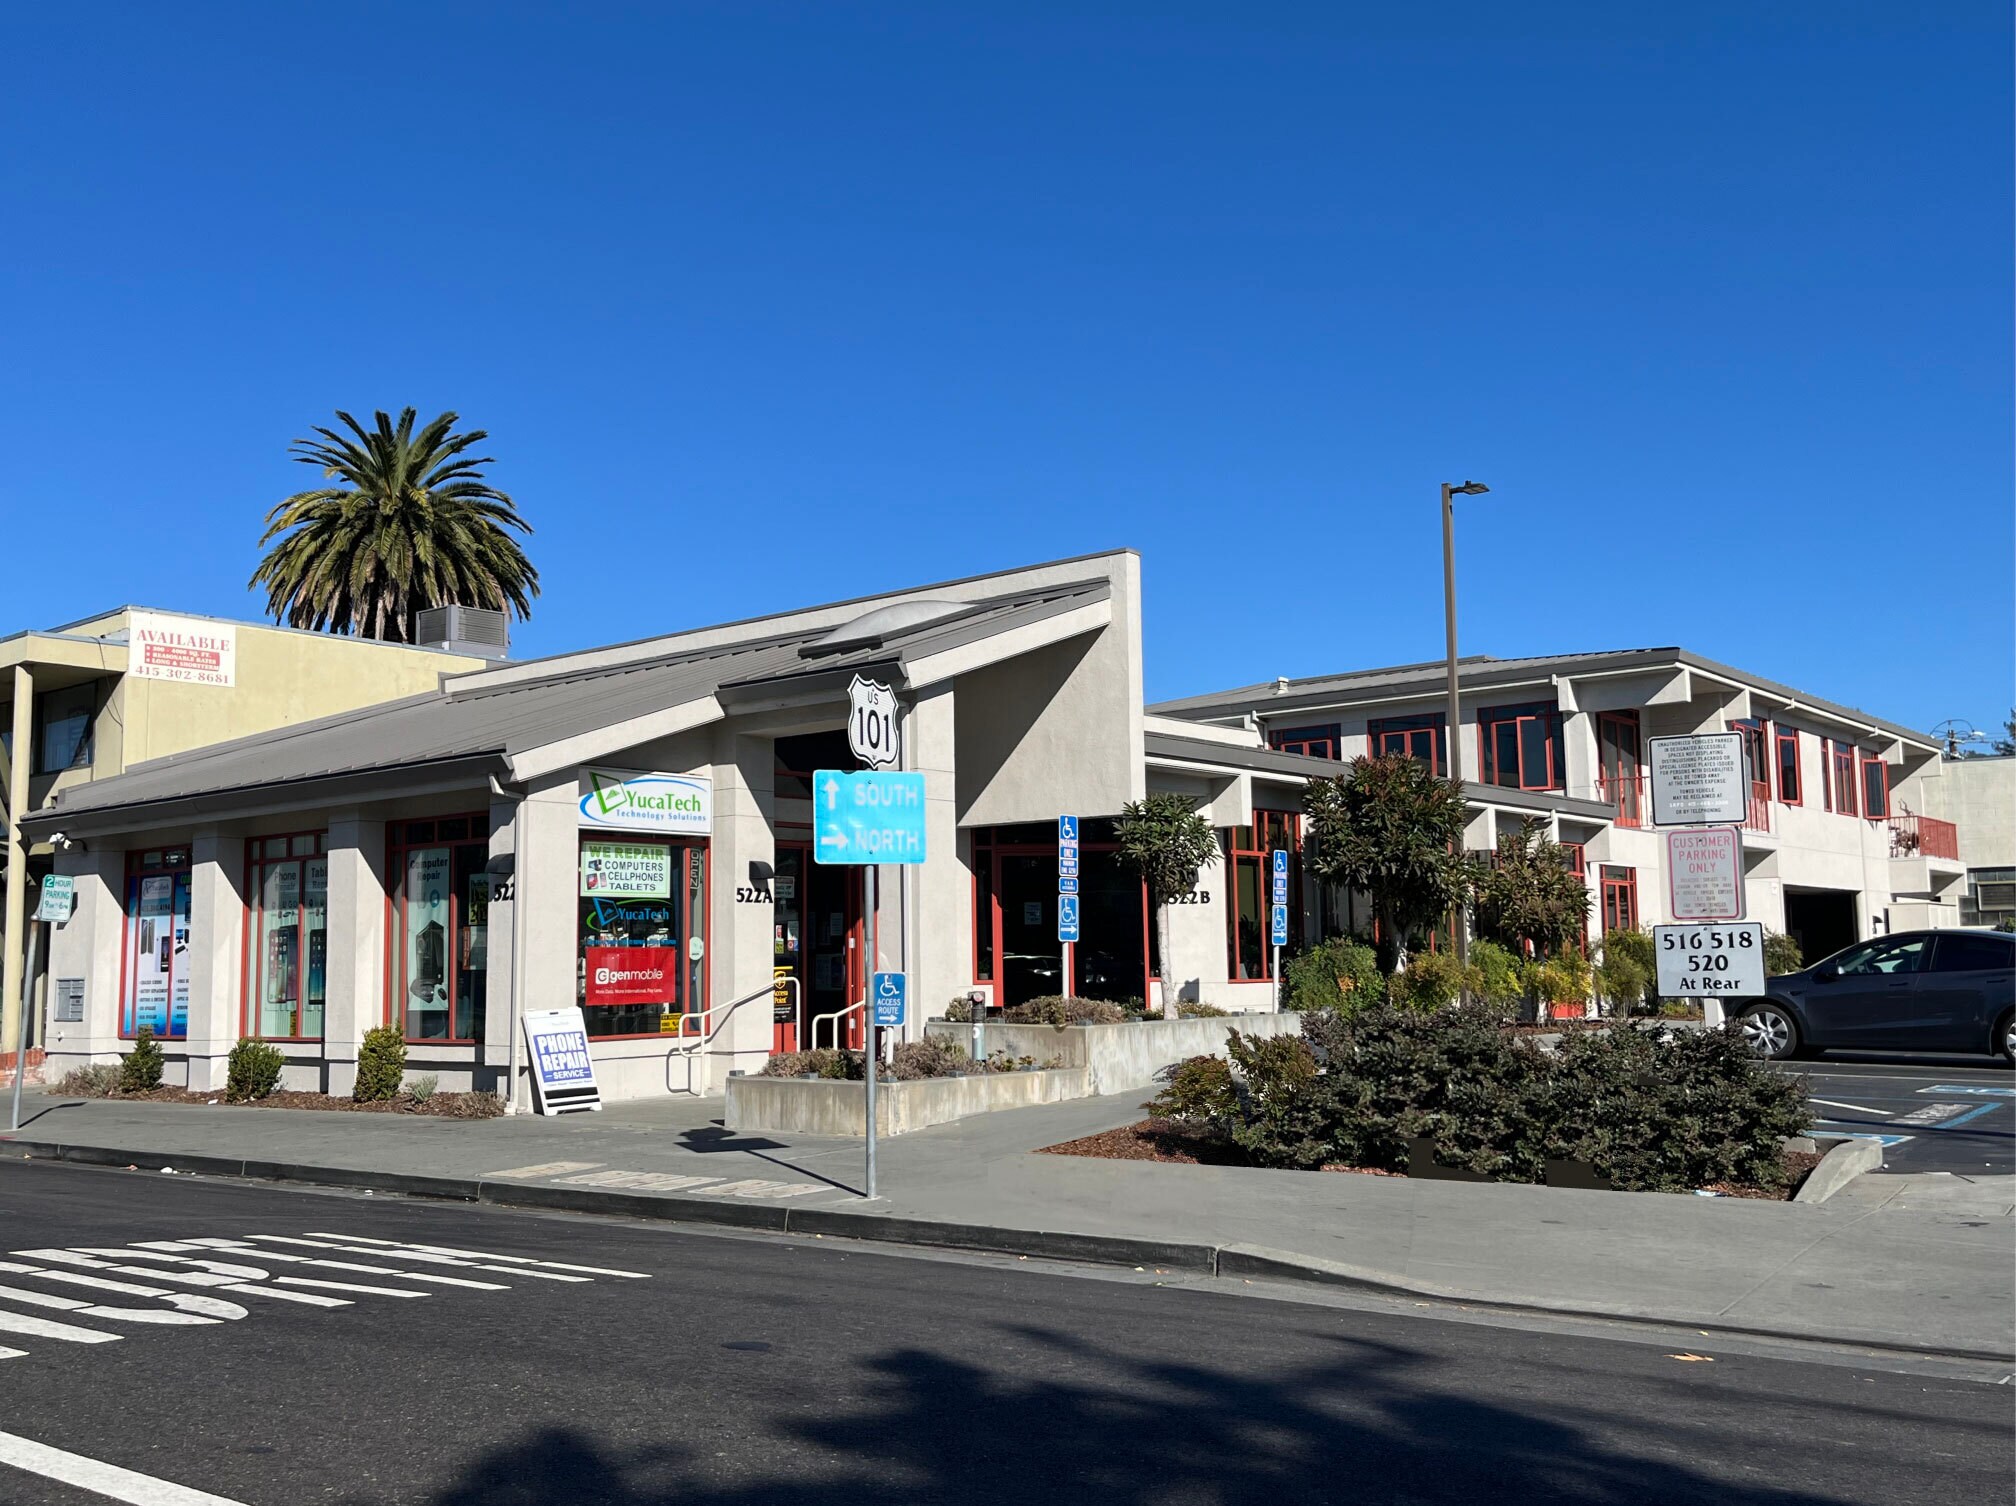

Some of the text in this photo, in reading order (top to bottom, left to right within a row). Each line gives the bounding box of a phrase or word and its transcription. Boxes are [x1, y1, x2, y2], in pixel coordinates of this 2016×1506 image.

[137, 629, 230, 651] AVAILABLE
[153, 652, 194, 662] REASONABLE
[136, 666, 228, 684] 415-302-8681
[867, 690, 879, 705] US
[858, 706, 889, 752] 101
[626, 790, 701, 812] YucaTech
[855, 783, 918, 806] SOUTH
[616, 809, 706, 822] Technology Solutions
[855, 828, 920, 851] NORTH
[1673, 836, 1730, 849] CUSTOMER
[589, 846, 664, 860] WE REPAIR
[1679, 849, 1726, 860] PARKING
[605, 861, 663, 872] COMPUTERS
[690, 851, 699, 887] OPEN
[1688, 862, 1716, 873] ONLY
[46, 876, 54, 887] 2
[608, 871, 664, 882] CELLPHONES
[609, 882, 656, 891] TABLETS
[46, 890, 70, 900] PARKING
[736, 887, 773, 903] 522A
[618, 908, 669, 920] YucaTech
[1664, 931, 1752, 950] 516 518
[1688, 955, 1728, 971] 520
[610, 968, 663, 983] genmobile
[1680, 977, 1740, 989] At Rear
[877, 998, 901, 1006] ACCESS
[878, 1006, 899, 1014] ROUTE
[537, 1033, 584, 1054] PHONE
[541, 1051, 588, 1072] REPAIR
[553, 1069, 584, 1079] SERVICE
